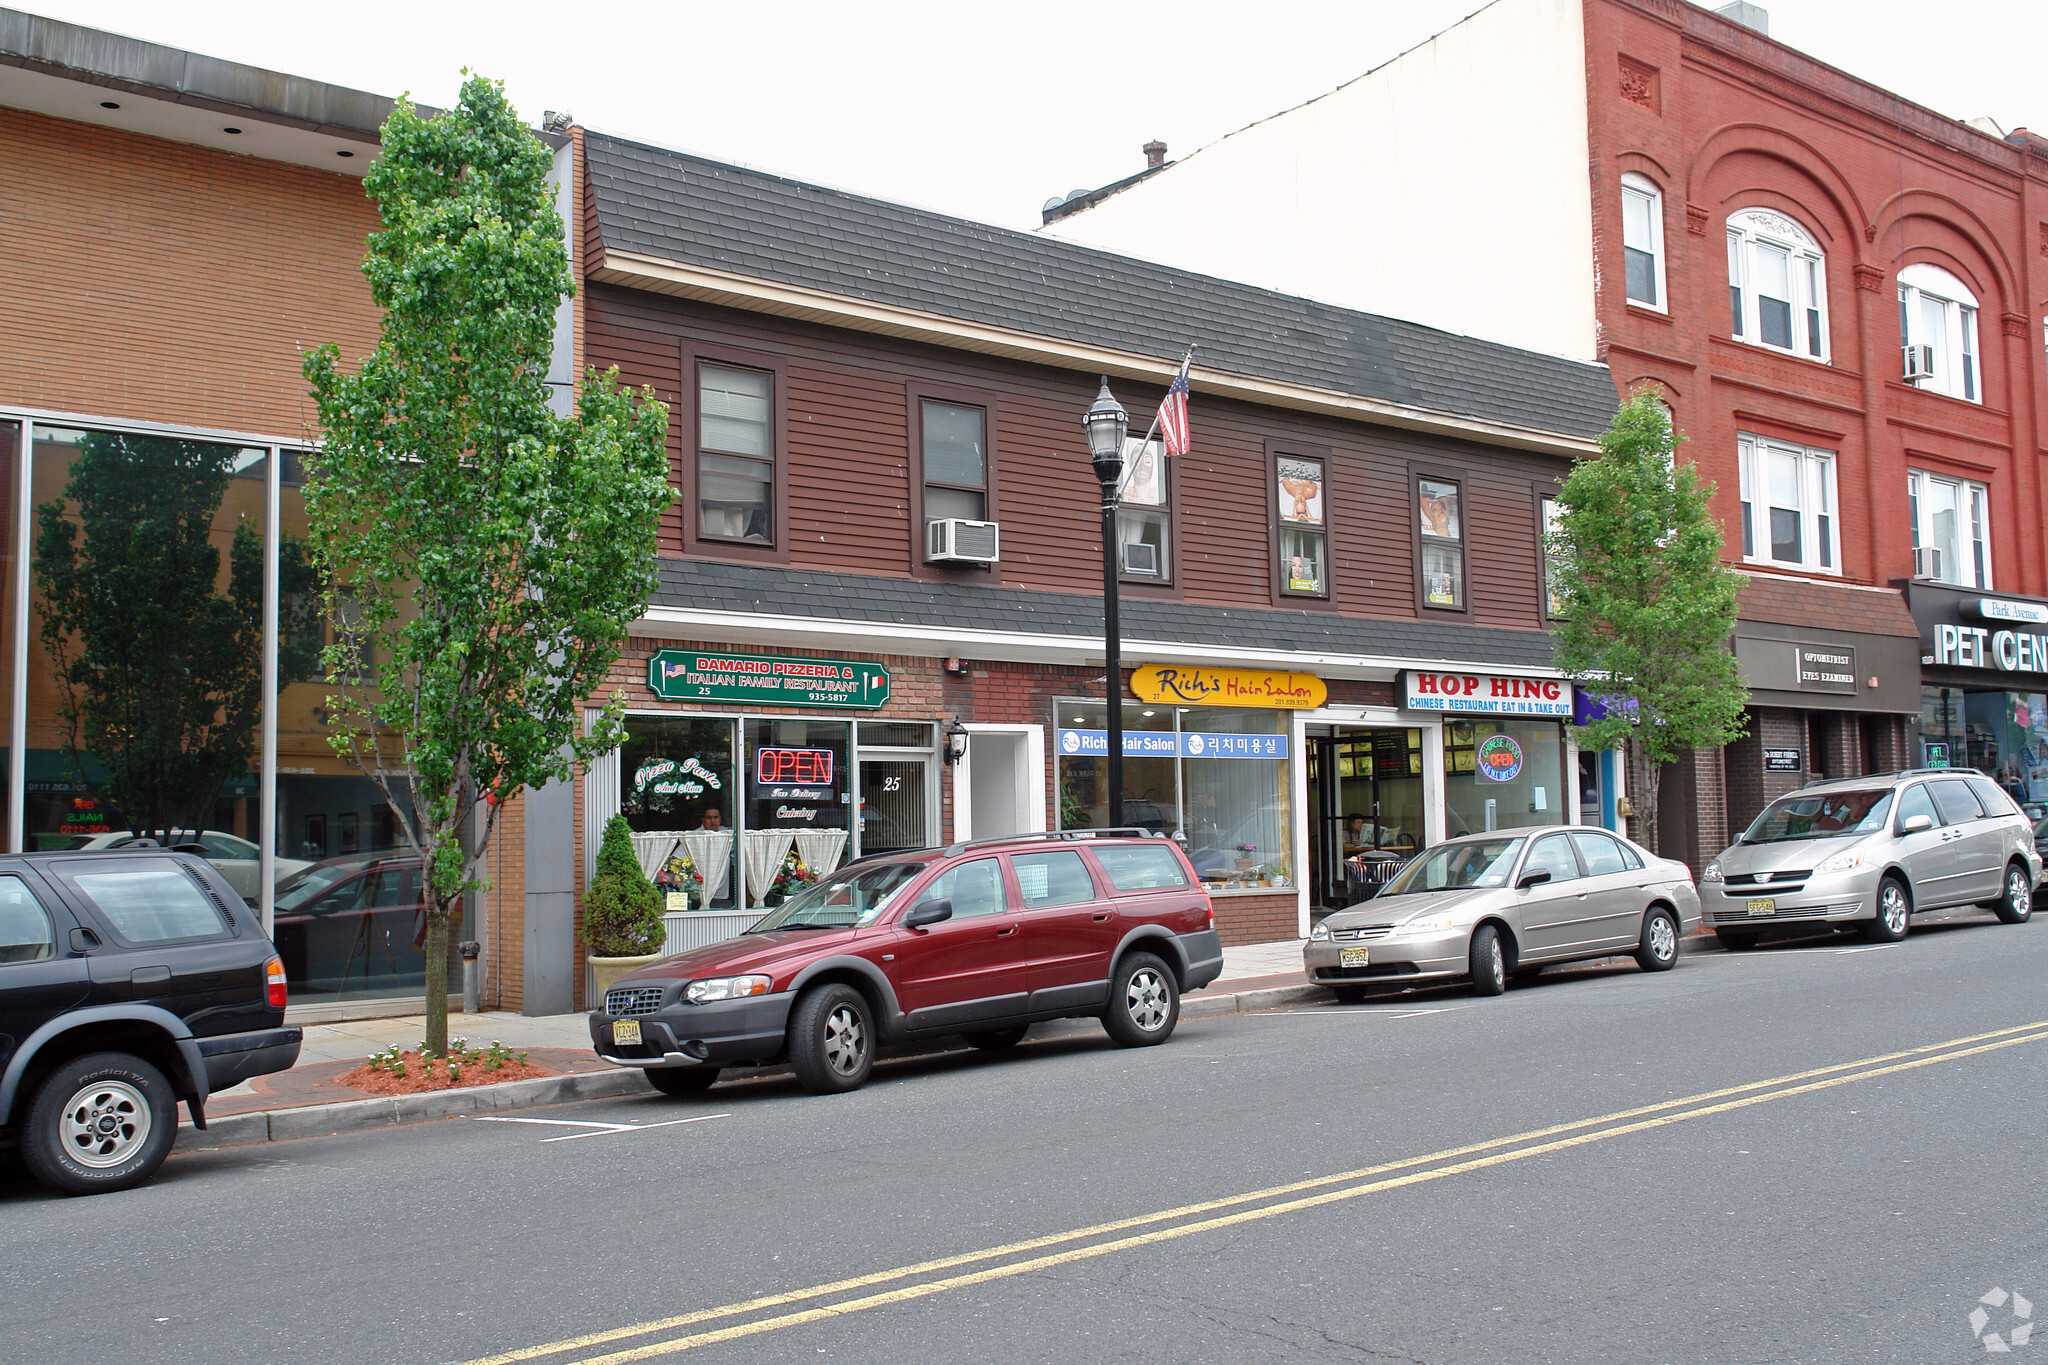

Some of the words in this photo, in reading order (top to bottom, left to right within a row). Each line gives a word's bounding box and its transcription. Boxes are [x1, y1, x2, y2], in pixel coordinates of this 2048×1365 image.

[1991, 601, 2009, 617] Park
[2012, 605, 2039, 620] Avenue
[1934, 624, 1988, 667] PET
[1992, 630, 2048, 673] CEN
[1804, 653, 1849, 665] OPTOMETRIST
[696, 658, 770, 674] DAMARIO
[773, 663, 838, 679] PIZZERIA
[842, 667, 854, 679] &
[1802, 671, 1820, 681] EYES
[1821, 673, 1855, 683] EXAMINED
[686, 673, 735, 687] ITALIAN
[738, 675, 781, 689] FAMILY
[784, 678, 859, 693] RESTAURANT
[698, 687, 711, 696] 25
[1155, 669, 1220, 702] Rich's
[1226, 677, 1262, 698] Hair
[1263, 675, 1312, 698] Salon
[1417, 673, 1480, 696] HOP
[1489, 677, 1561, 701] HING
[808, 693, 848, 702] 935-5817
[1409, 697, 1444, 709] CHINESE
[1449, 699, 1499, 712] RESTAURANT
[1502, 702, 1516, 712] EAT
[1518, 702, 1526, 713] IN
[1528, 703, 1534, 713] &
[1535, 703, 1553, 714] TAKE
[1555, 704, 1570, 715] OUT
[1144, 738, 1175, 751] Salon
[1505, 740, 1520, 759] FOOD
[760, 750, 831, 783] OPEN
[1490, 753, 1514, 767] OPEN
[635, 761, 674, 792] Pizza
[680, 757, 721, 790] Pasta
[654, 781, 678, 793] And
[678, 781, 704, 793] More
[883, 777, 901, 791] 25
[776, 804, 817, 820] Catering
[78, 1068, 127, 1084] Radial
[131, 1072, 149, 1087] T/A
